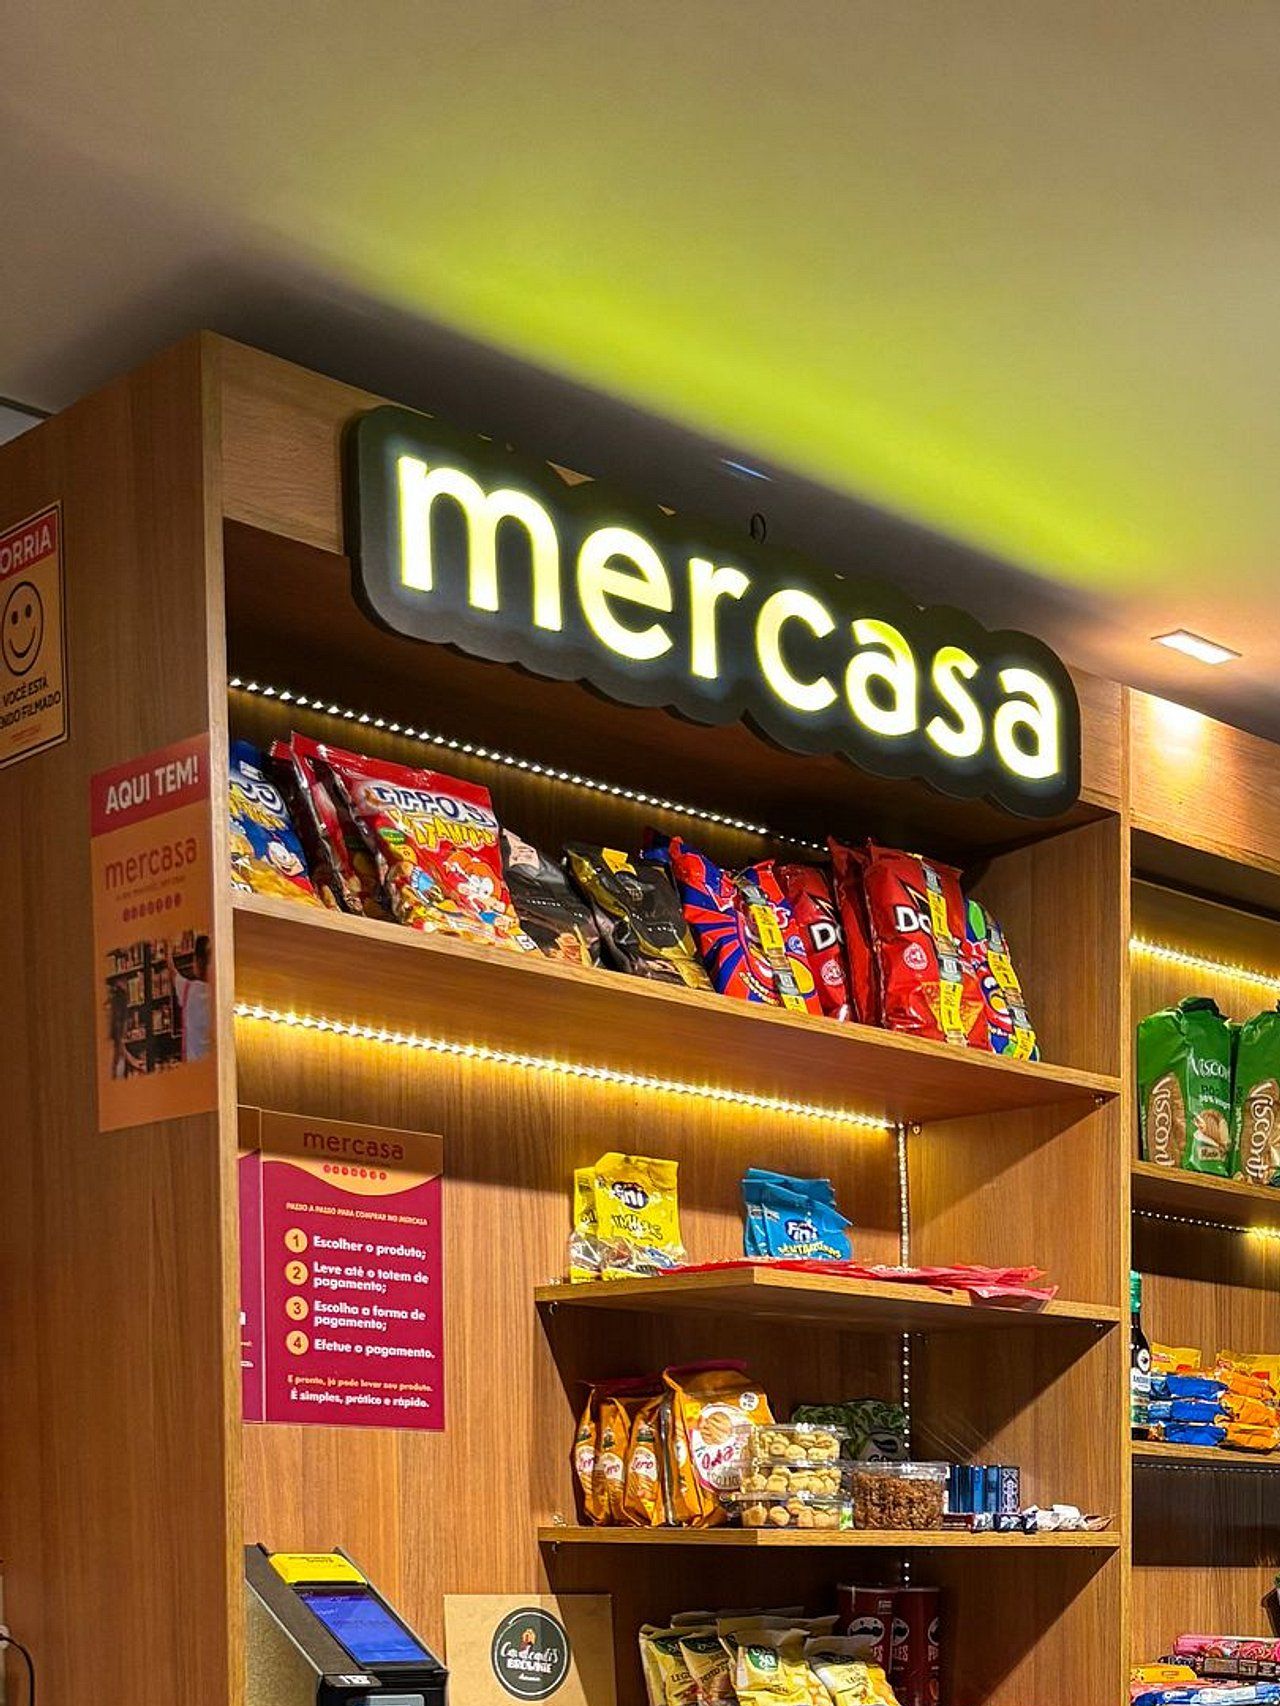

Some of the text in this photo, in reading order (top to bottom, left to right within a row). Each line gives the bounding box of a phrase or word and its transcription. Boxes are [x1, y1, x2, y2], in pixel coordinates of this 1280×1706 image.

[0, 525, 52, 575] ORRIA
[397, 453, 1062, 781] mercasa
[21, 692, 62, 722] FILMADO
[105, 755, 199, 815] AQUI TEM!
[105, 837, 198, 891] mercasa
[1188, 1052, 1230, 1078] Visco
[303, 1130, 405, 1161] mercasa
[313, 1235, 362, 1253] Escolher
[365, 1243, 374, 1254] o
[376, 1241, 427, 1261] produto;
[313, 1261, 342, 1276] Leve
[344, 1263, 365, 1279] até
[367, 1268, 376, 1279] o
[377, 1267, 412, 1284] totem
[413, 1271, 429, 1285] de
[313, 1276, 387, 1294] pagamento;
[313, 1300, 360, 1319] Escolha
[372, 1304, 408, 1321] forma
[410, 1308, 427, 1321] de
[313, 1315, 387, 1332] pagamento;
[313, 1337, 352, 1354] Efetue
[354, 1344, 363, 1354] o
[365, 1343, 436, 1361] pagamento.
[290, 1387, 430, 1410] É simples, prático e rápido.
[506, 1658, 553, 1674] BROWNIE
